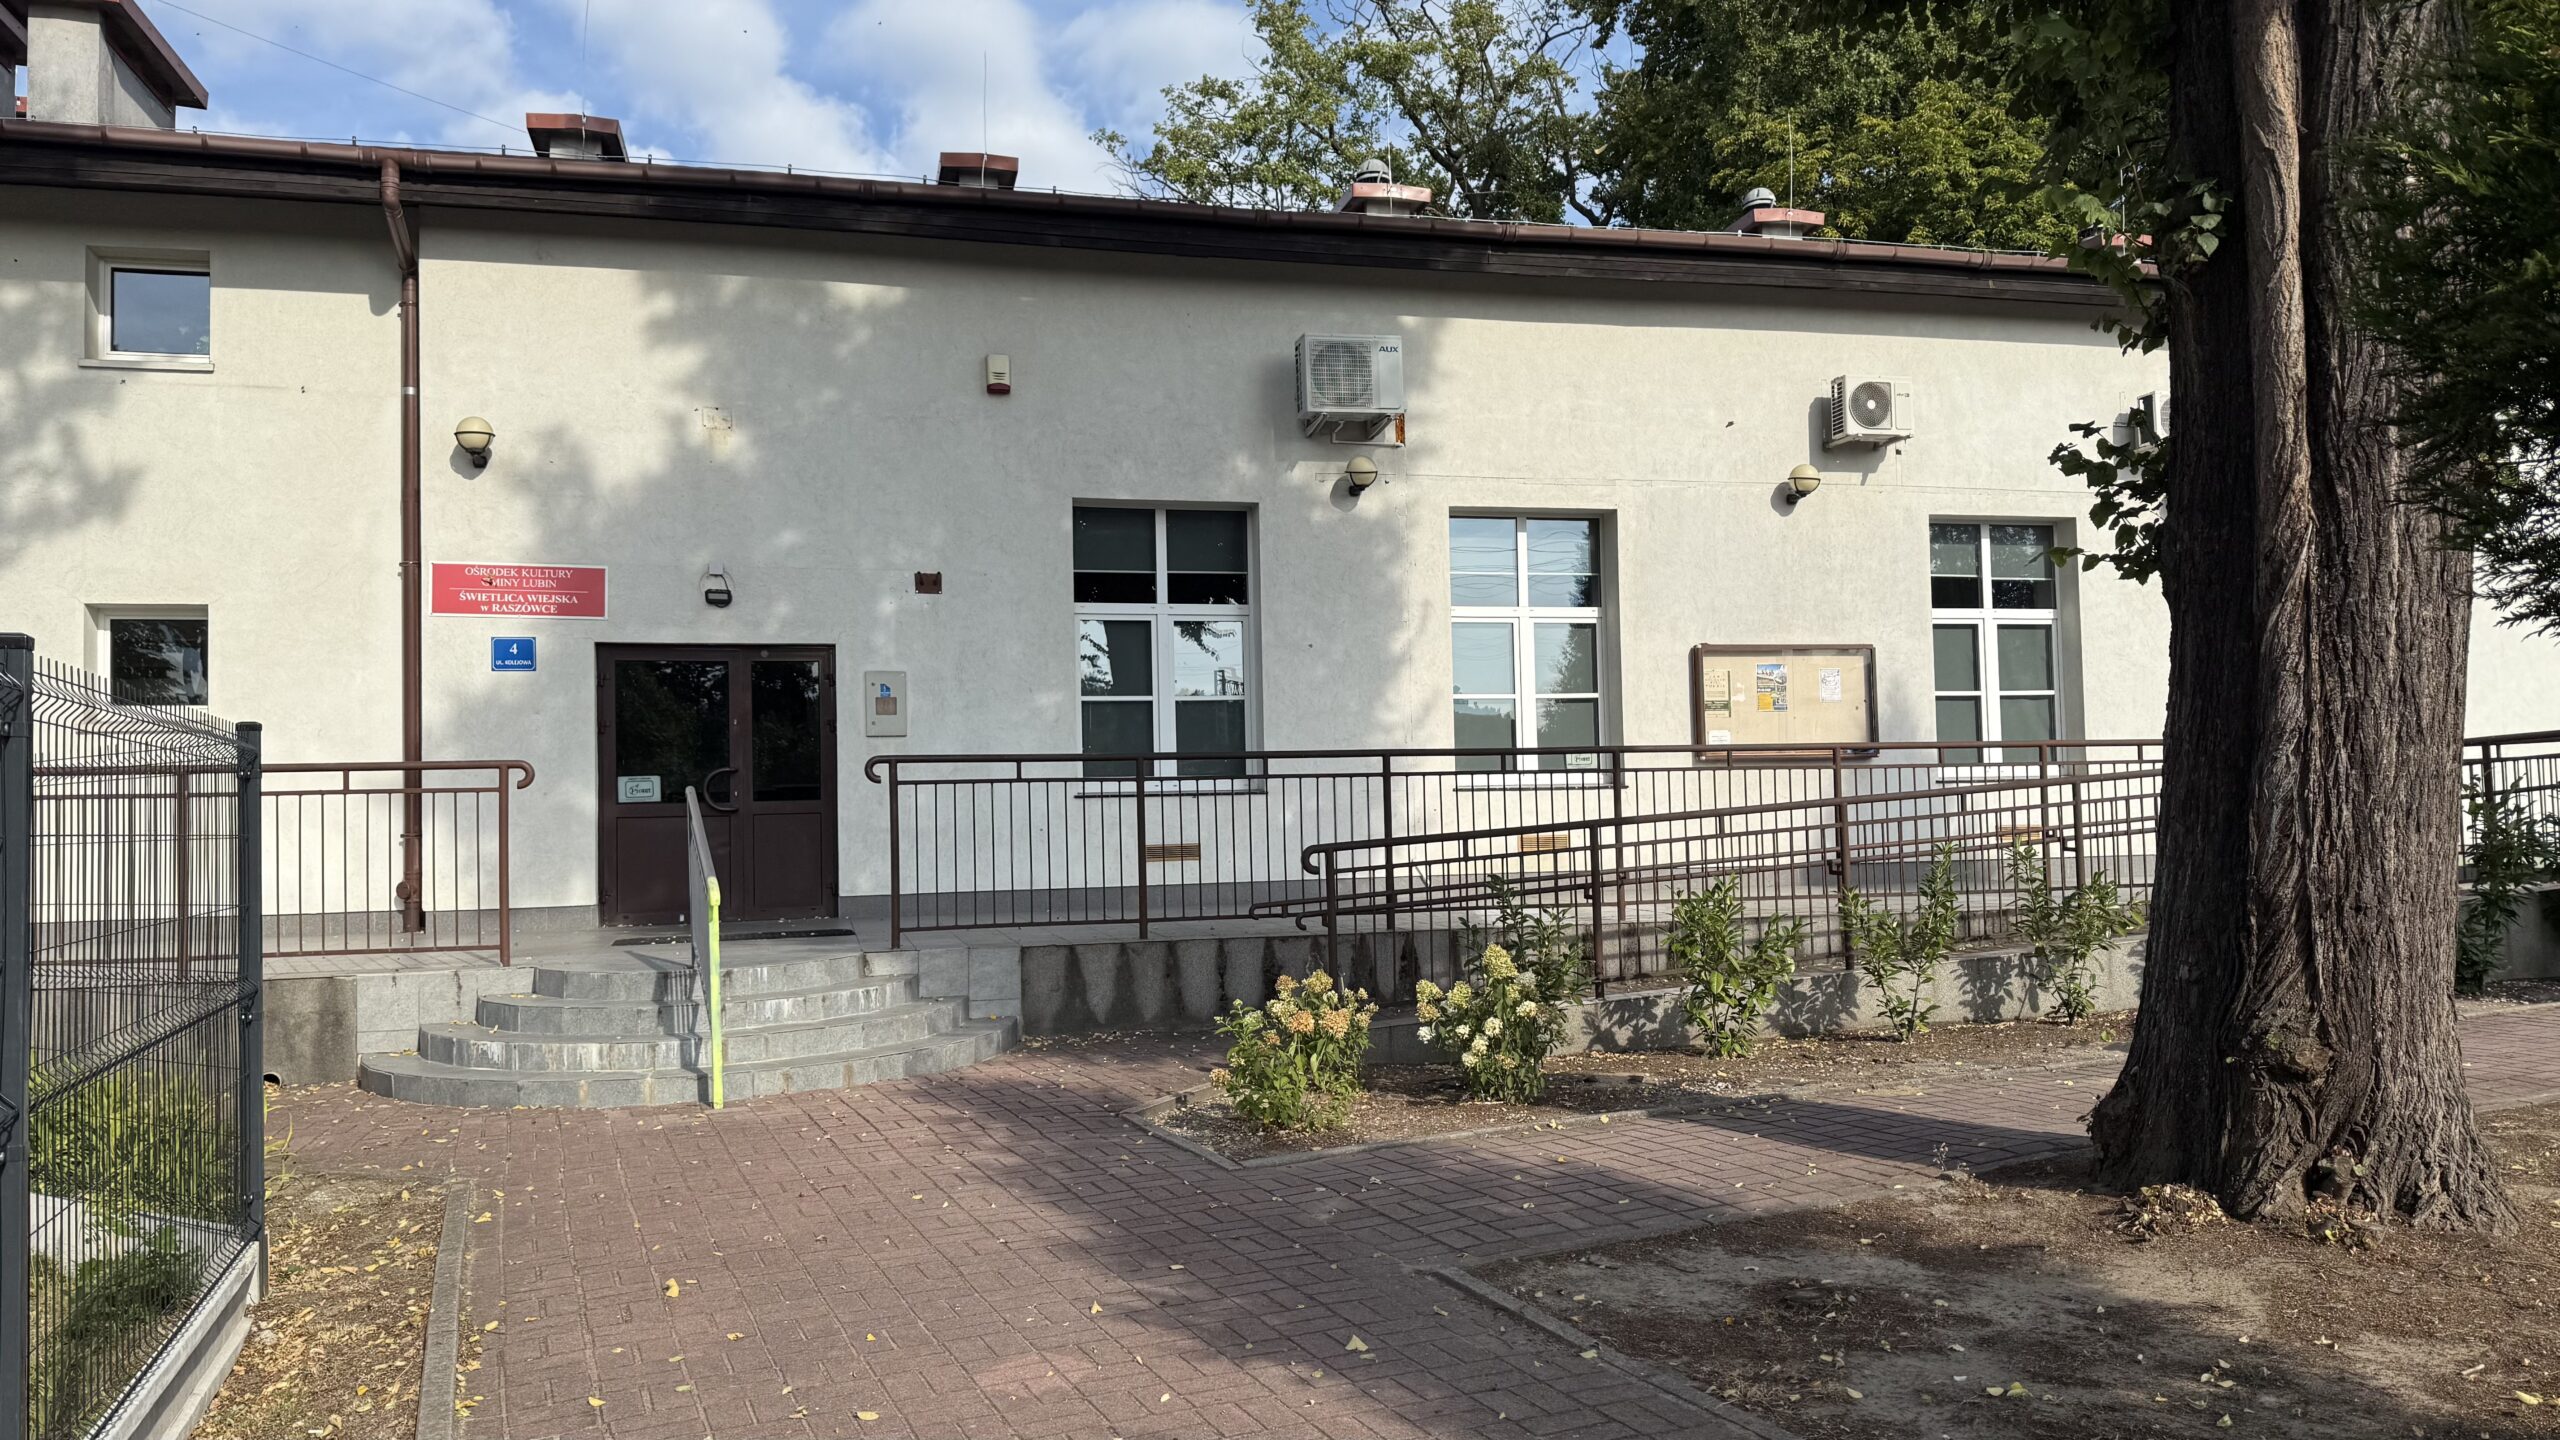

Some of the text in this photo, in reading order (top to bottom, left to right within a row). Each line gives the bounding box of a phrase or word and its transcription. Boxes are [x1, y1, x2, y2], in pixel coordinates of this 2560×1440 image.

[1379, 345, 1399, 353] AUX
[465, 566, 573, 579] OŚRODEK KULTURY
[522, 578, 557, 589] LUBIN
[459, 590, 578, 604] ŚWIETLICA WIEJSKA
[492, 602, 558, 613] RASZÓWCE
[509, 643, 518, 655] 4
